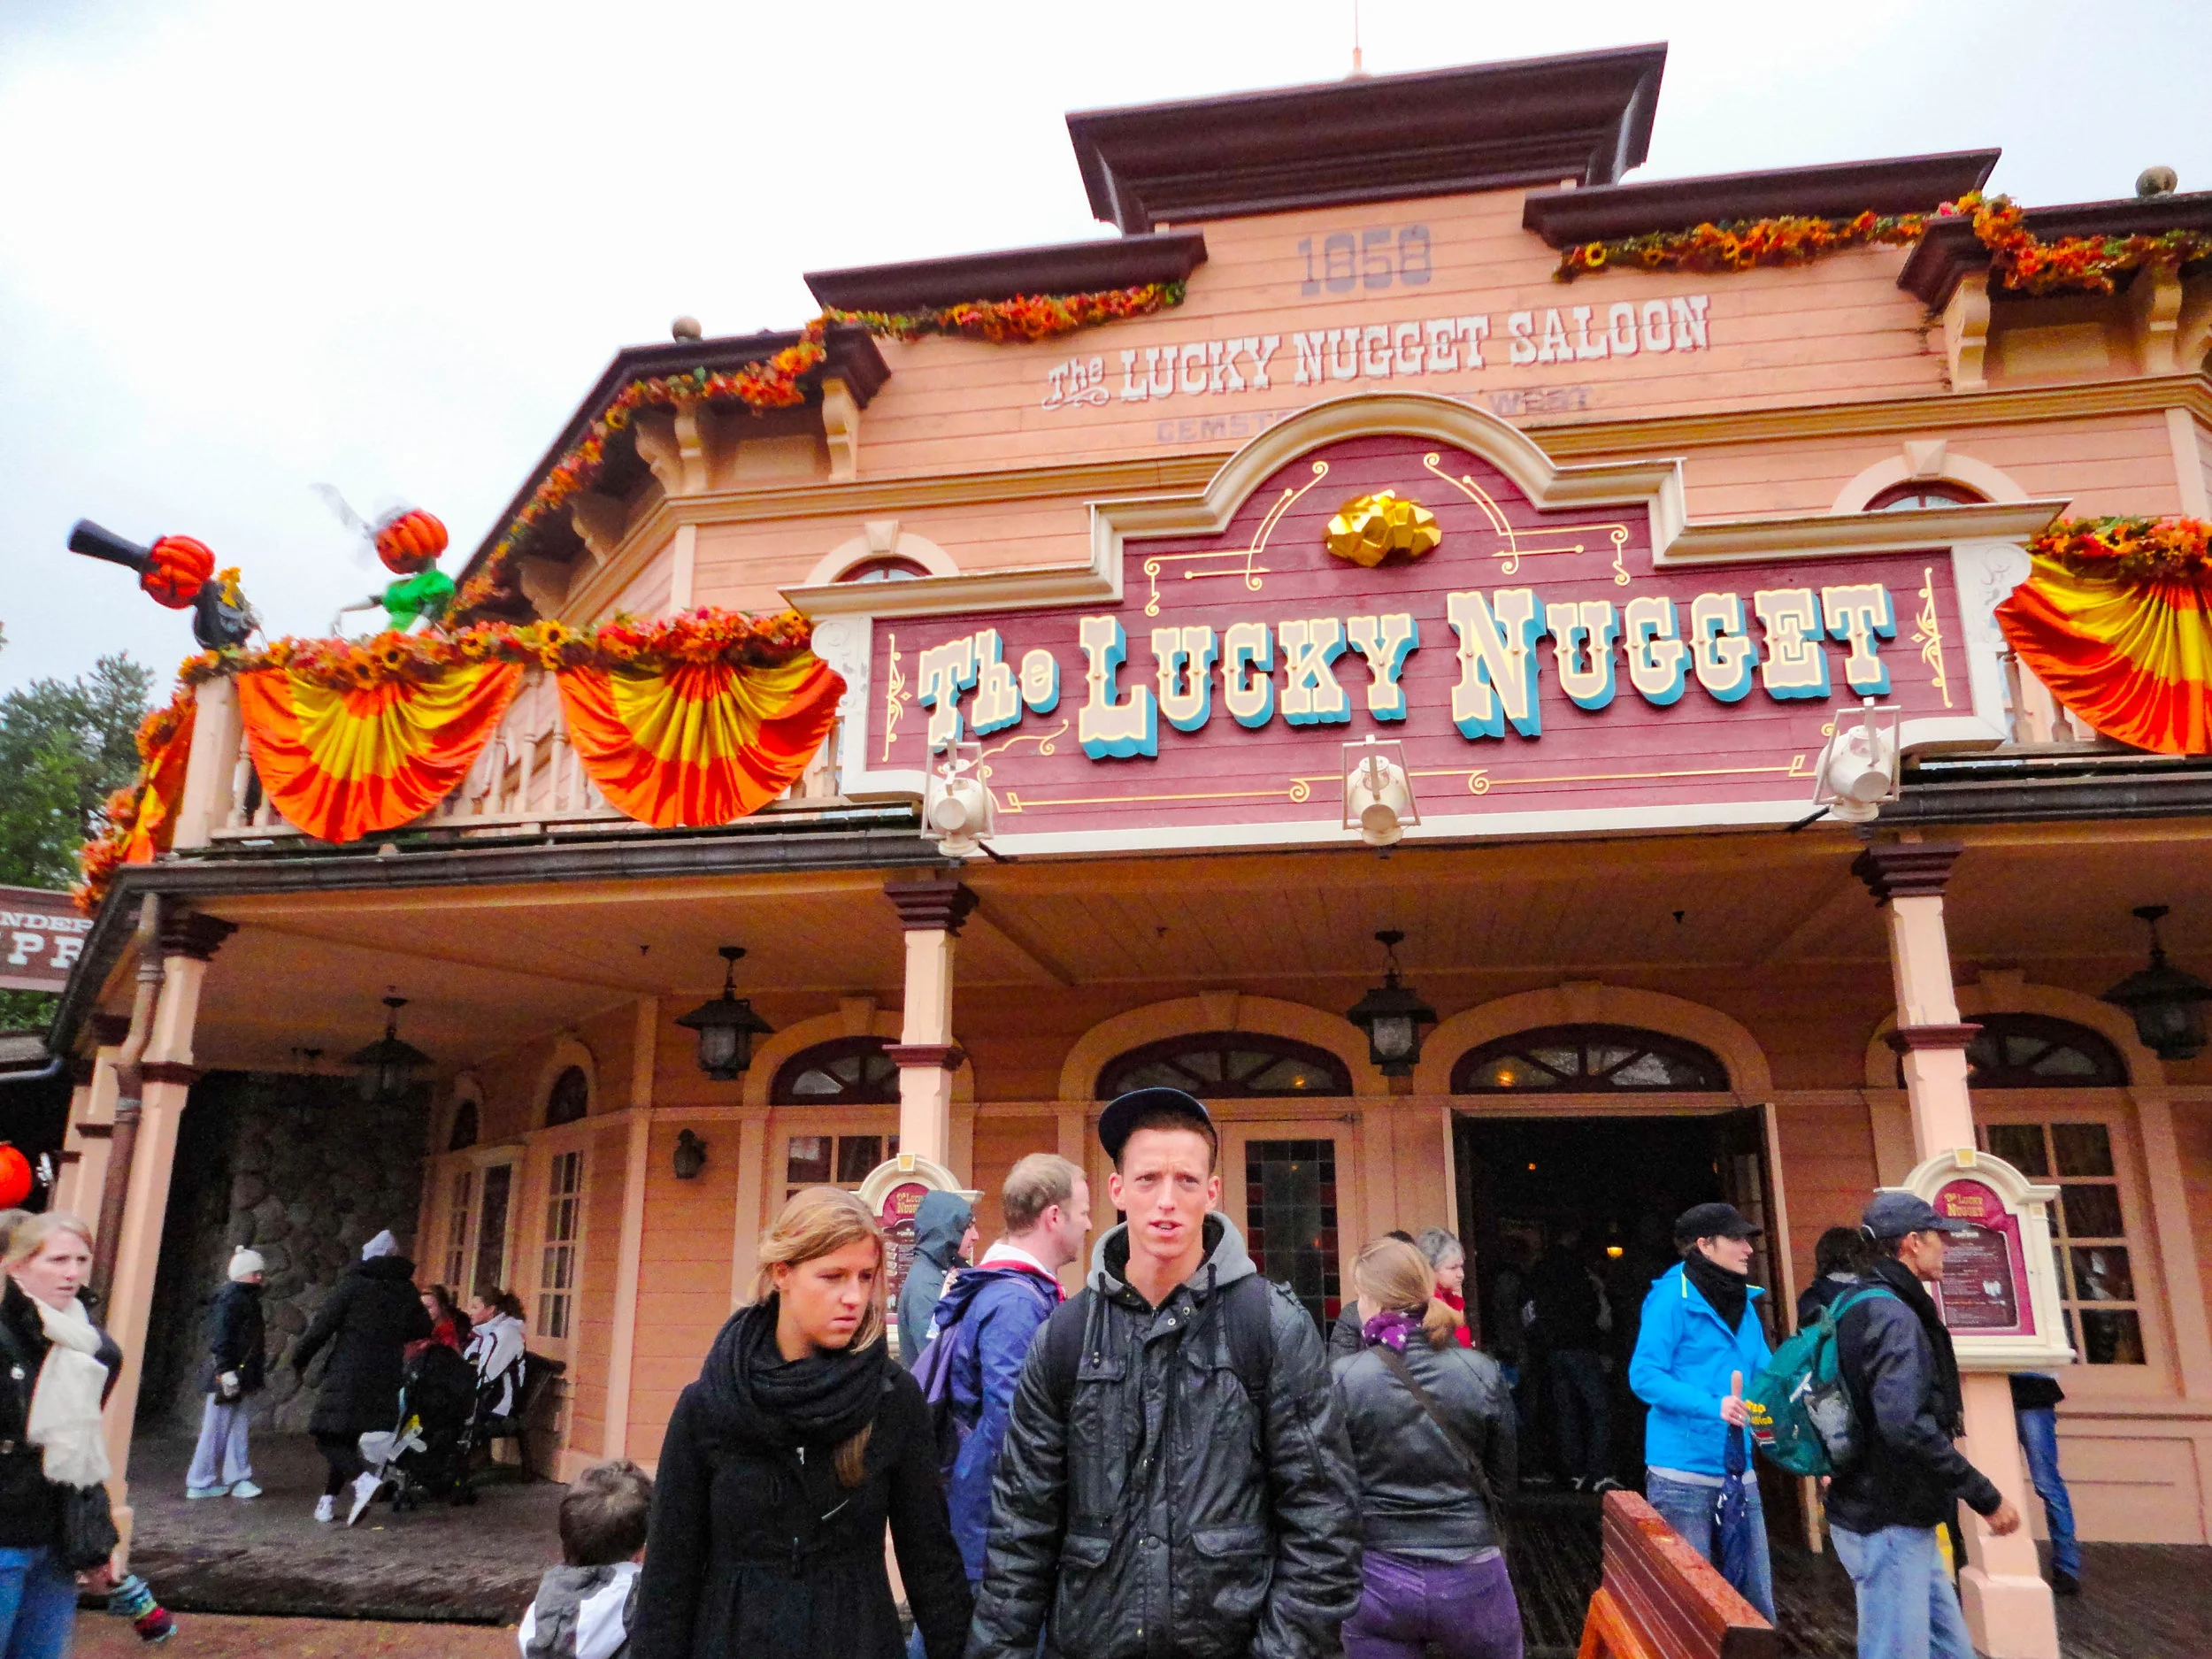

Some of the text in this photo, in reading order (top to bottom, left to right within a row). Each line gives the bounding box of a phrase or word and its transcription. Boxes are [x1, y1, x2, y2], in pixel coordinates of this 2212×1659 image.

[1298, 223, 1432, 296] 1858
[1042, 294, 1711, 409] The LUCKY NUGGET SALOON
[918, 582, 1898, 760] The LUCKY NUGGET
